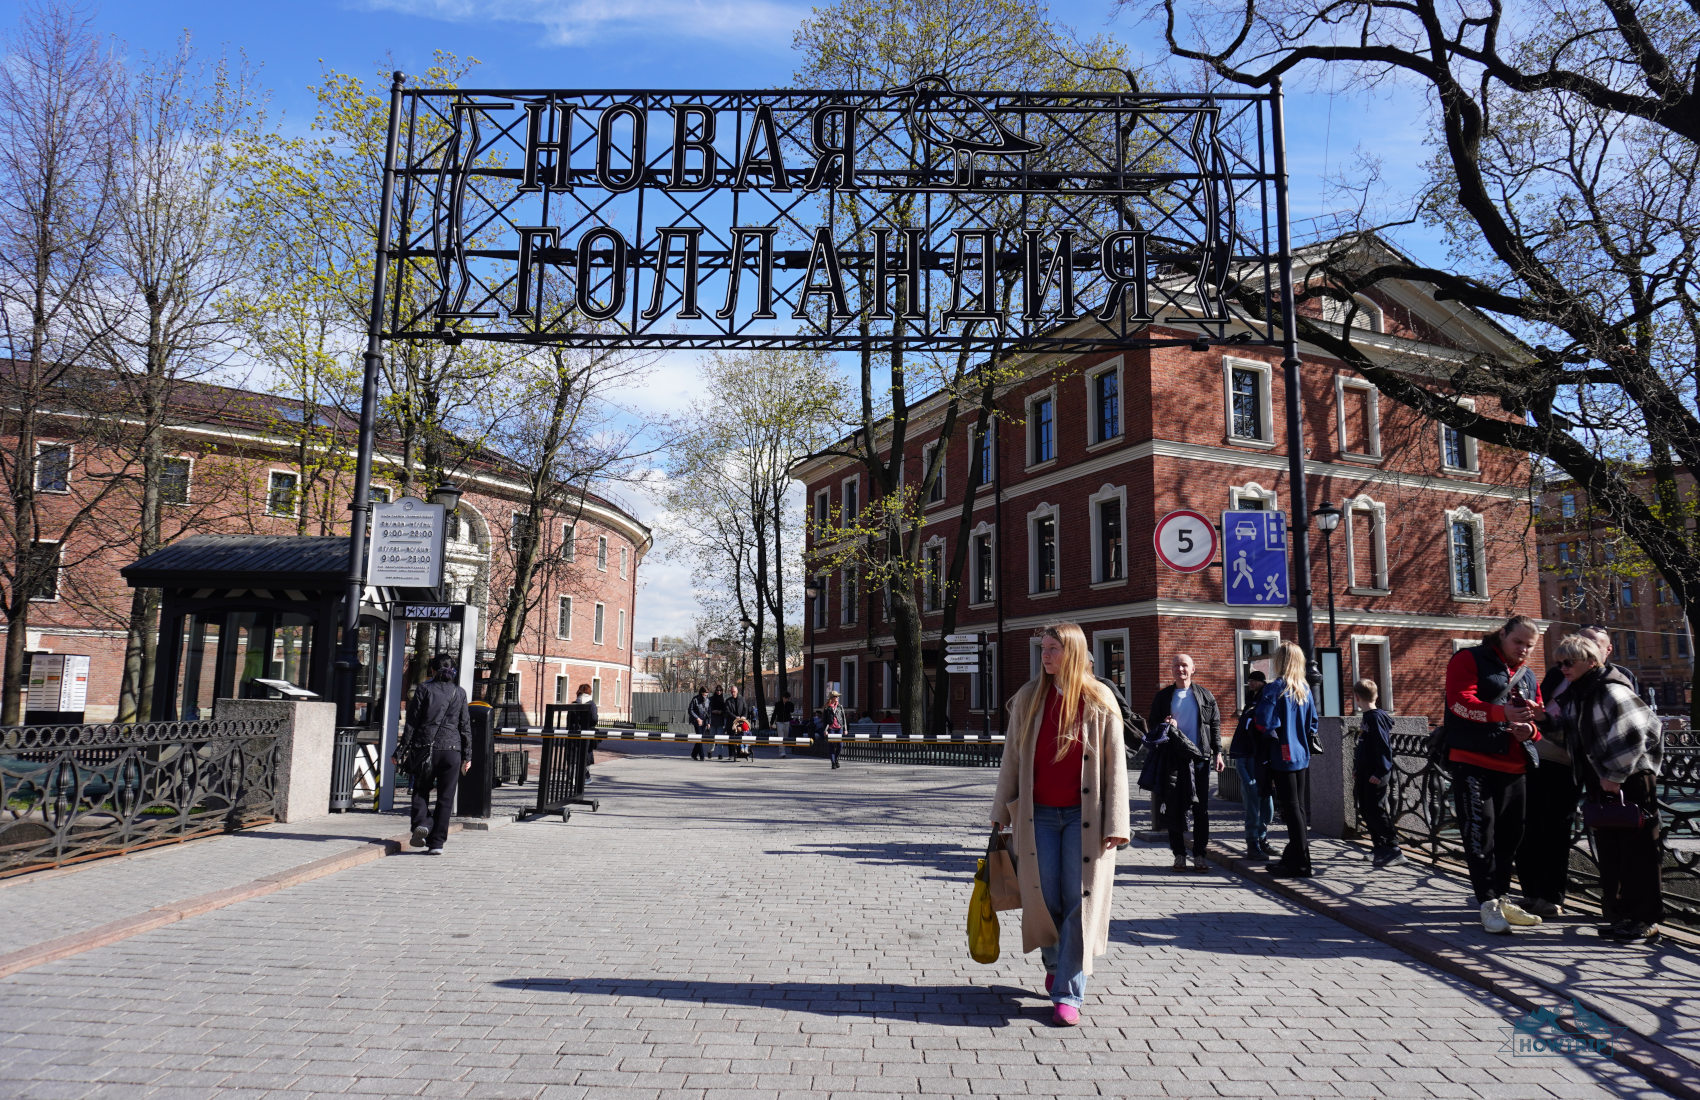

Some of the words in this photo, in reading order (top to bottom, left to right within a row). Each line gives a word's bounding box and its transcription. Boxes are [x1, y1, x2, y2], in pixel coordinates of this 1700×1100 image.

[517, 102, 862, 194] НОВАЯ
[508, 224, 1154, 333] ГОЛЛАНДИЯ
[1177, 529, 1194, 553] 5
[1466, 776, 1483, 821] GORILLA
[1471, 822, 1484, 856] WEAR
